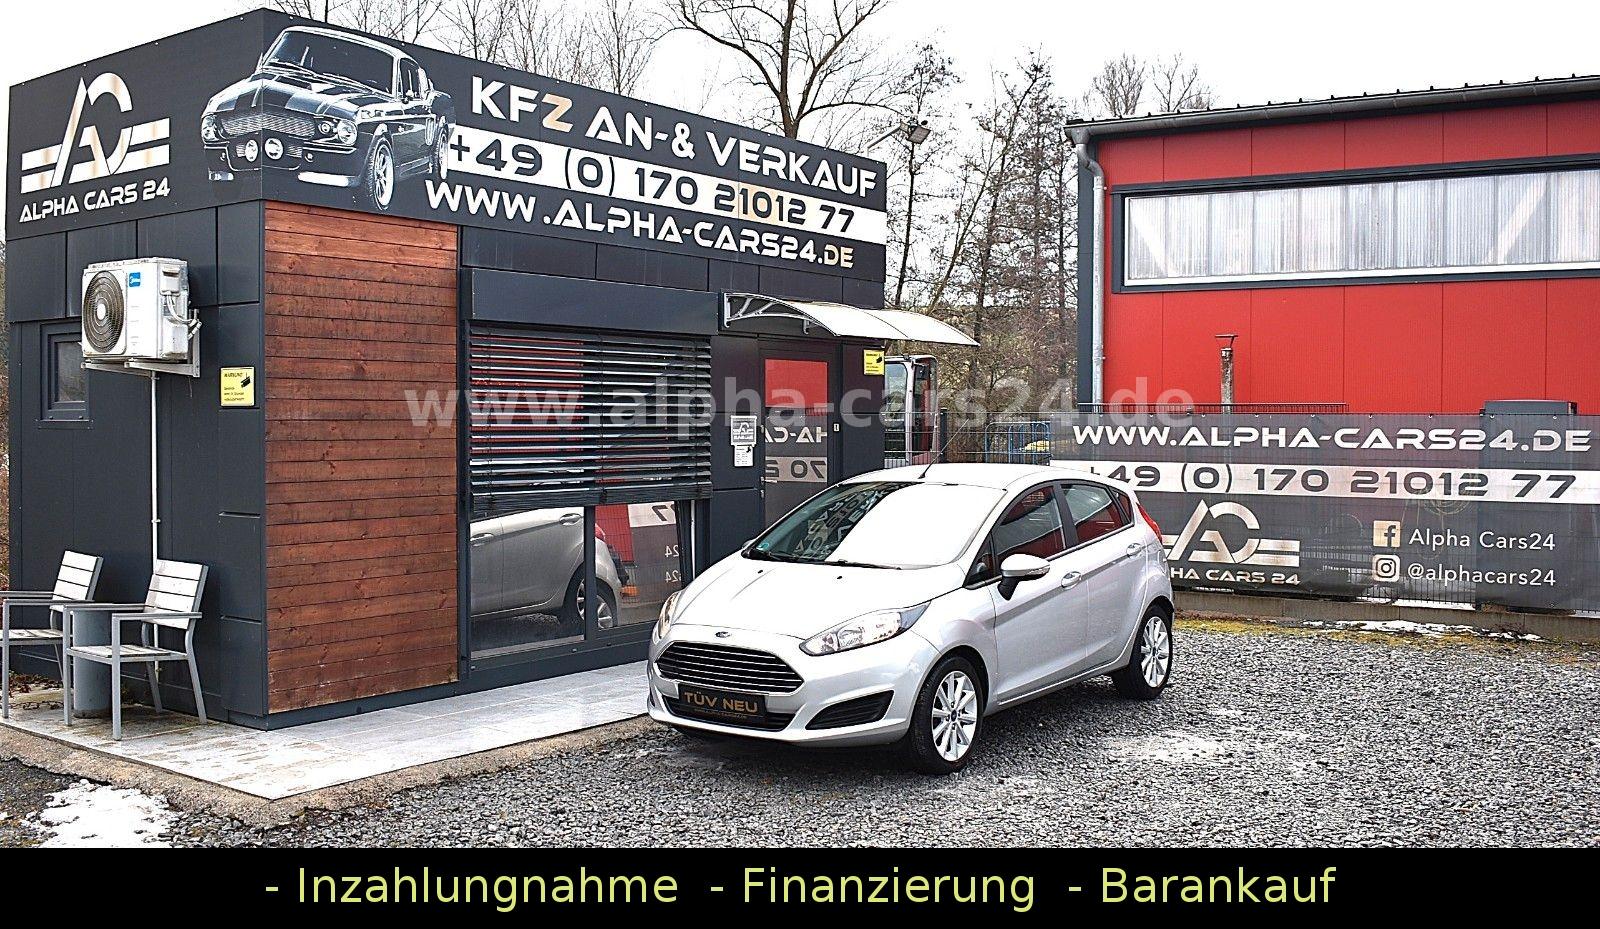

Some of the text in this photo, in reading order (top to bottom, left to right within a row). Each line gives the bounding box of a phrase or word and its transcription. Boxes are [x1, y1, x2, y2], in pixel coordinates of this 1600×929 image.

[472, 76, 574, 133] KFZ
[706, 131, 877, 198] VERKAUF
[449, 134, 855, 233] +49 (0) 170 21012 77
[19, 176, 170, 223] ALPHA CARS 24
[1072, 425, 1592, 452] WWW.ALPHA-CARS24.DE
[1181, 463, 1232, 493] (0)
[1253, 468, 1331, 492] 170
[1350, 470, 1489, 497] 21012
[1511, 474, 1577, 499] 77
[1409, 528, 1556, 551] Alpha Cars24
[1206, 569, 1266, 584] CARS
[1271, 573, 1300, 586] 24
[1407, 562, 1556, 587] @alphacars24
[684, 691, 758, 713] TÜV NEU
